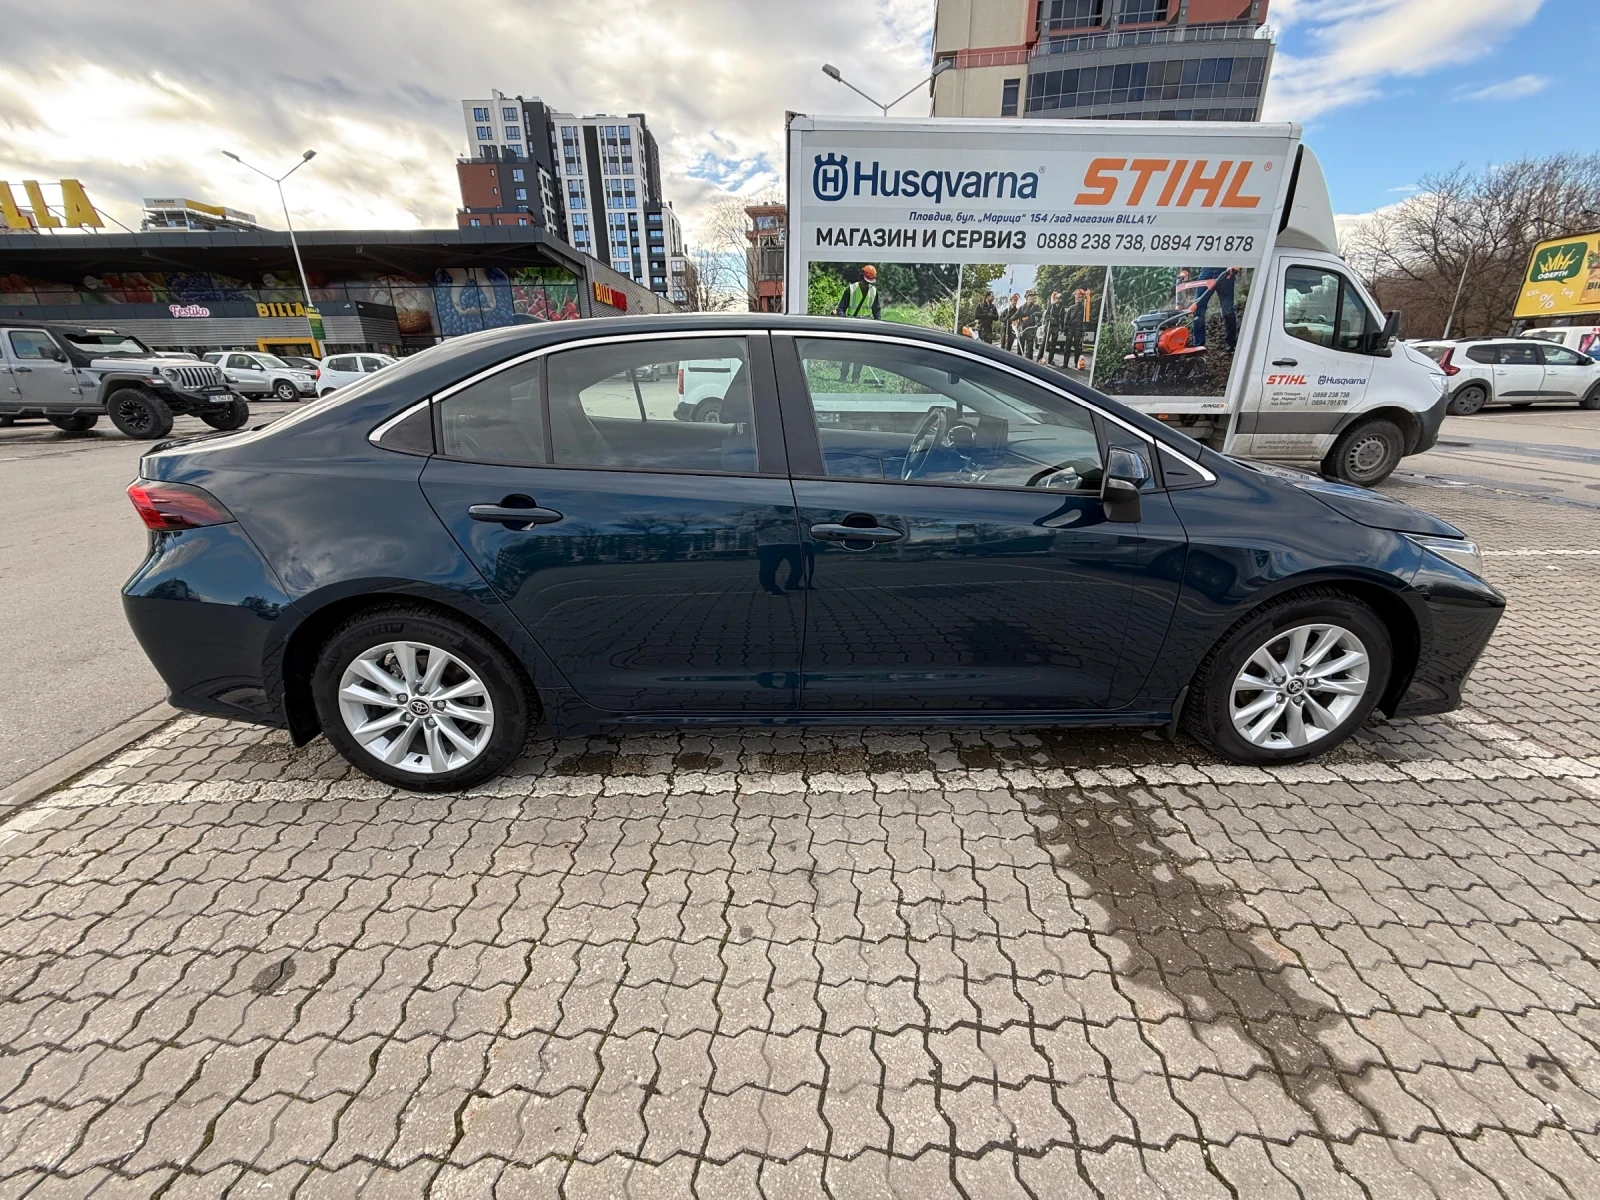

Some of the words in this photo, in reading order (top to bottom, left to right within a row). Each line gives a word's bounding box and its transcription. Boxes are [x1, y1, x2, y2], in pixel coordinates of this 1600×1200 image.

[853, 161, 1039, 203] Husqvarna
[1073, 158, 1261, 208] STIHL
[909, 211, 953, 223] Пловдив,
[956, 211, 976, 224] бул.
[1030, 213, 1048, 222] 154
[1049, 213, 1072, 224] /зад
[1073, 215, 1114, 223] магазин
[1115, 214, 1144, 224] BILLA
[816, 227, 917, 248] МАГАЗИН
[922, 229, 937, 248] И
[942, 229, 1027, 249] СЕРВИЗ
[1036, 232, 1077, 250] 0888
[1081, 233, 1111, 250] 238
[1115, 234, 1146, 252] 738,
[1150, 234, 1192, 251] 0894
[1195, 235, 1221, 251] 791
[1223, 235, 1254, 252] 878
[1537, 270, 1569, 280] ОФЕРТИ
[169, 304, 210, 318] Festiko
[256, 302, 307, 317] BILLA
[1266, 375, 1307, 385] STIHL
[1326, 376, 1366, 386] Husqvarna
